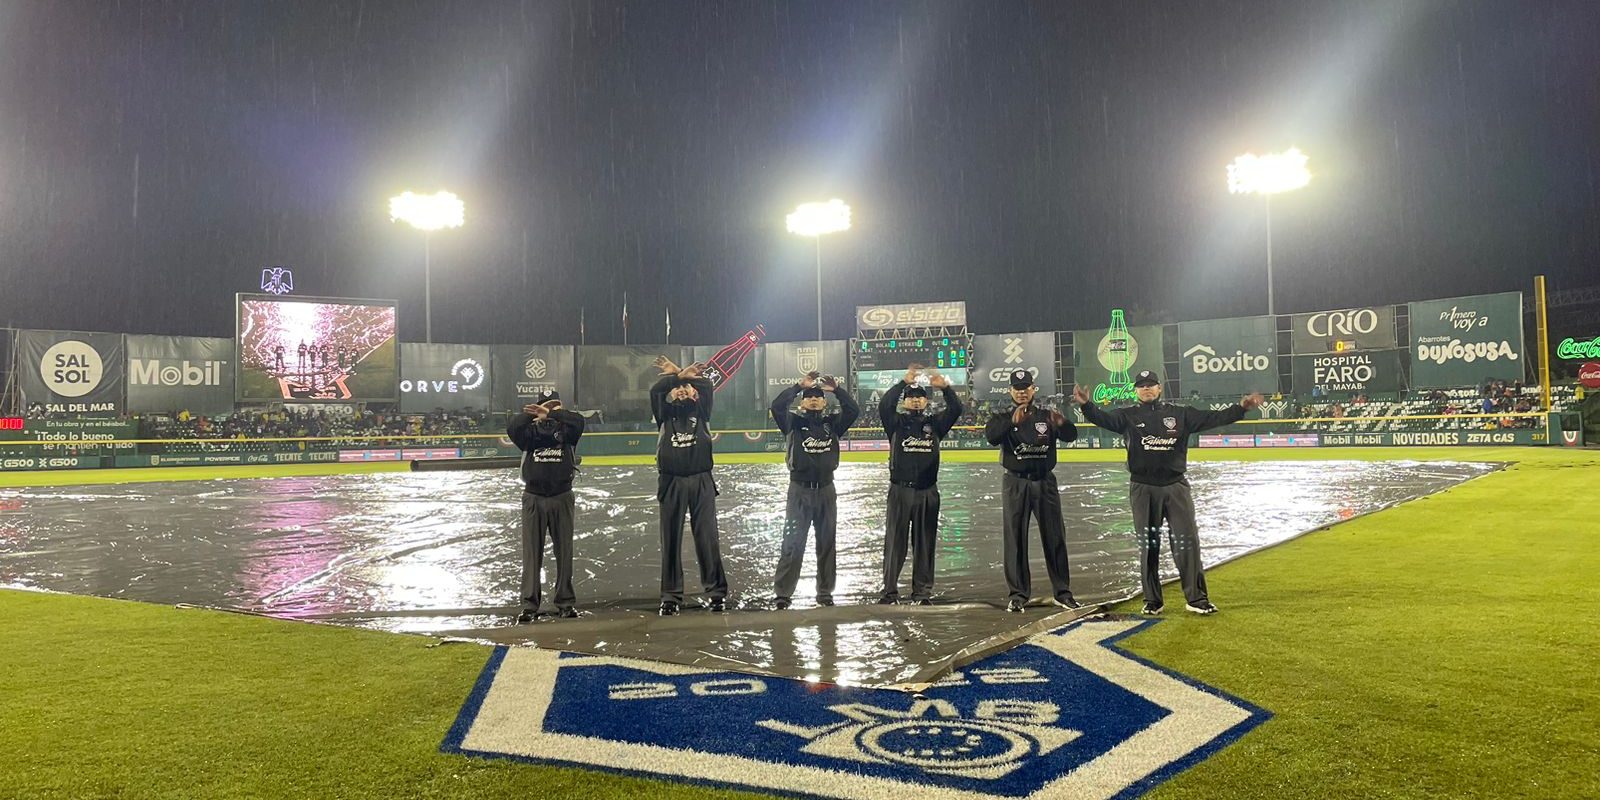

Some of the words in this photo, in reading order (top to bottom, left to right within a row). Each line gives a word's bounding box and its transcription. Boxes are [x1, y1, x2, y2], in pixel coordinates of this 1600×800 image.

[1454, 318, 1477, 332] voy
[1478, 316, 1489, 327] a
[55, 354, 90, 368] SAL
[1193, 351, 1269, 373] Boxito
[1314, 355, 1372, 367] HOSPITAL
[54, 370, 90, 384] SOL
[130, 359, 220, 386] Mobil
[989, 366, 1039, 382] G50
[1314, 365, 1372, 384] FARO
[45, 403, 66, 413] SAL
[69, 403, 88, 412] DEL
[90, 402, 115, 411] MAR
[69, 431, 79, 441] lo
[81, 431, 115, 441] bueno
[1324, 435, 1350, 445] Mobil
[1354, 434, 1381, 444] Mobil
[1392, 433, 1459, 445] NOVEDADES
[1467, 434, 1491, 443] ZETA
[1493, 433, 1515, 442] GAS
[940, 440, 959, 448] ECATE
[3, 459, 35, 468] G500
[49, 458, 79, 467] G500
[275, 453, 302, 463] TECATE
[308, 451, 337, 462] TECATE
